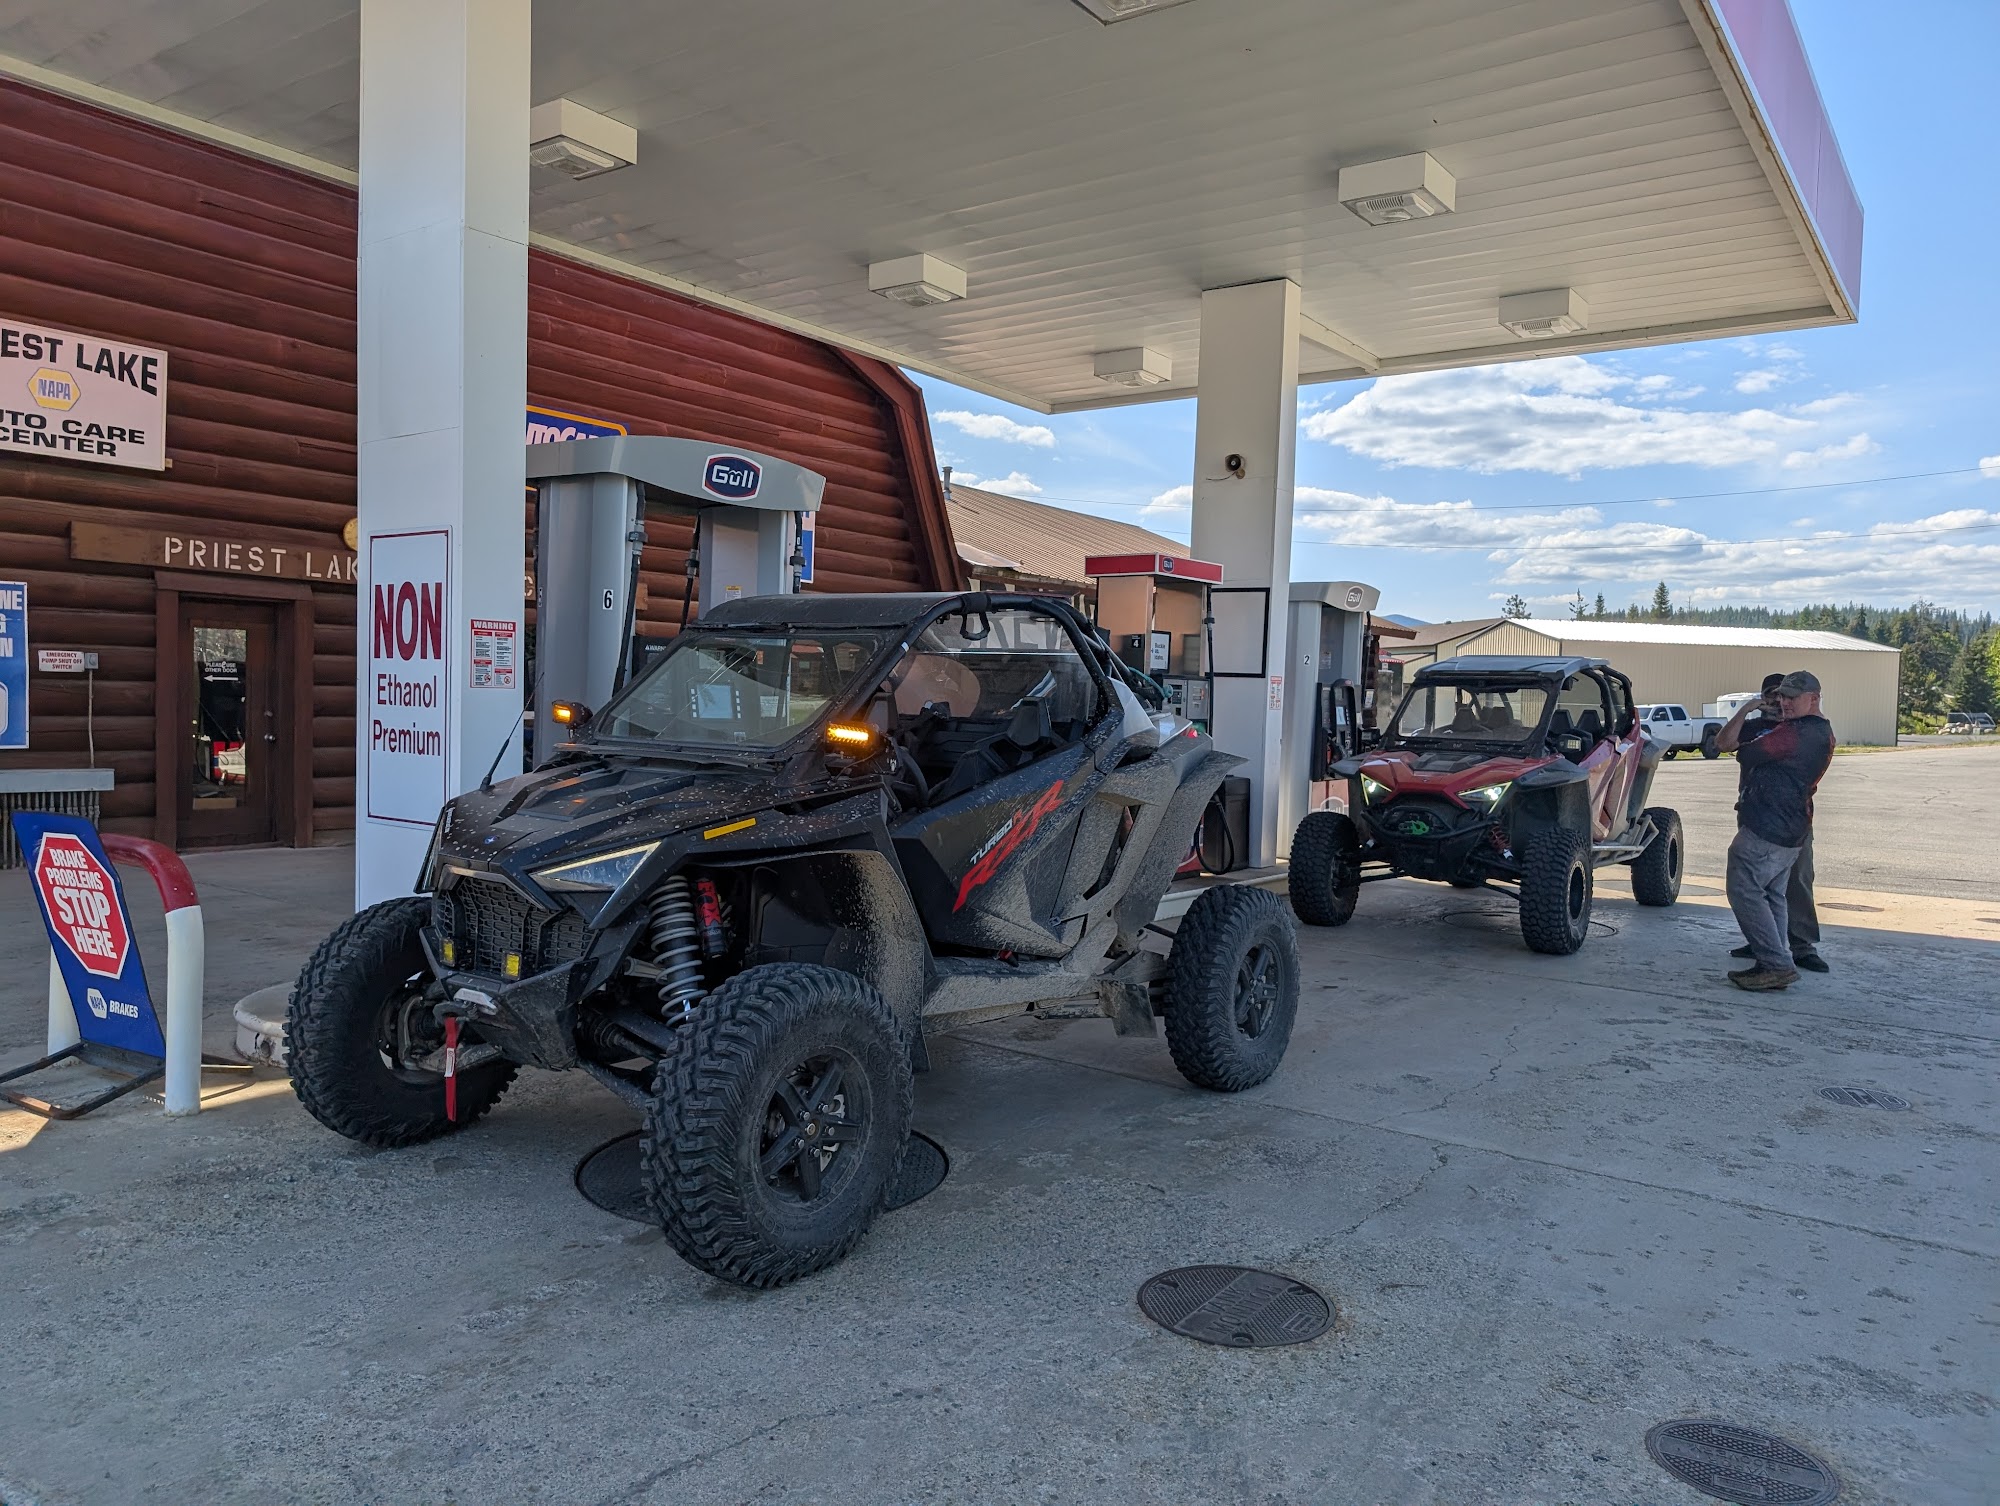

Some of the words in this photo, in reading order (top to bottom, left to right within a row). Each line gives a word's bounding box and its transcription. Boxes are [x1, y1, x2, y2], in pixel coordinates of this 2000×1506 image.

[76, 343, 158, 397] LAKE
[37, 378, 71, 400] NAPA
[61, 419, 145, 445] CARE
[711, 464, 754, 489] Gull
[164, 536, 287, 574] PRIEST
[604, 590, 612, 609] 6
[374, 581, 442, 661] NON
[473, 620, 514, 631] WARNING
[1133, 640, 1139, 648] 4
[1304, 655, 1310, 665] 2
[377, 673, 437, 708] Ethanol
[373, 719, 441, 756] Premium
[969, 818, 1014, 865] TURBO
[50, 848, 88, 870] BRAKE
[46, 867, 104, 891] PROBLEMS
[53, 886, 111, 930] STOP
[71, 925, 117, 960] HERE
[109, 1000, 139, 1019] BRAKES
